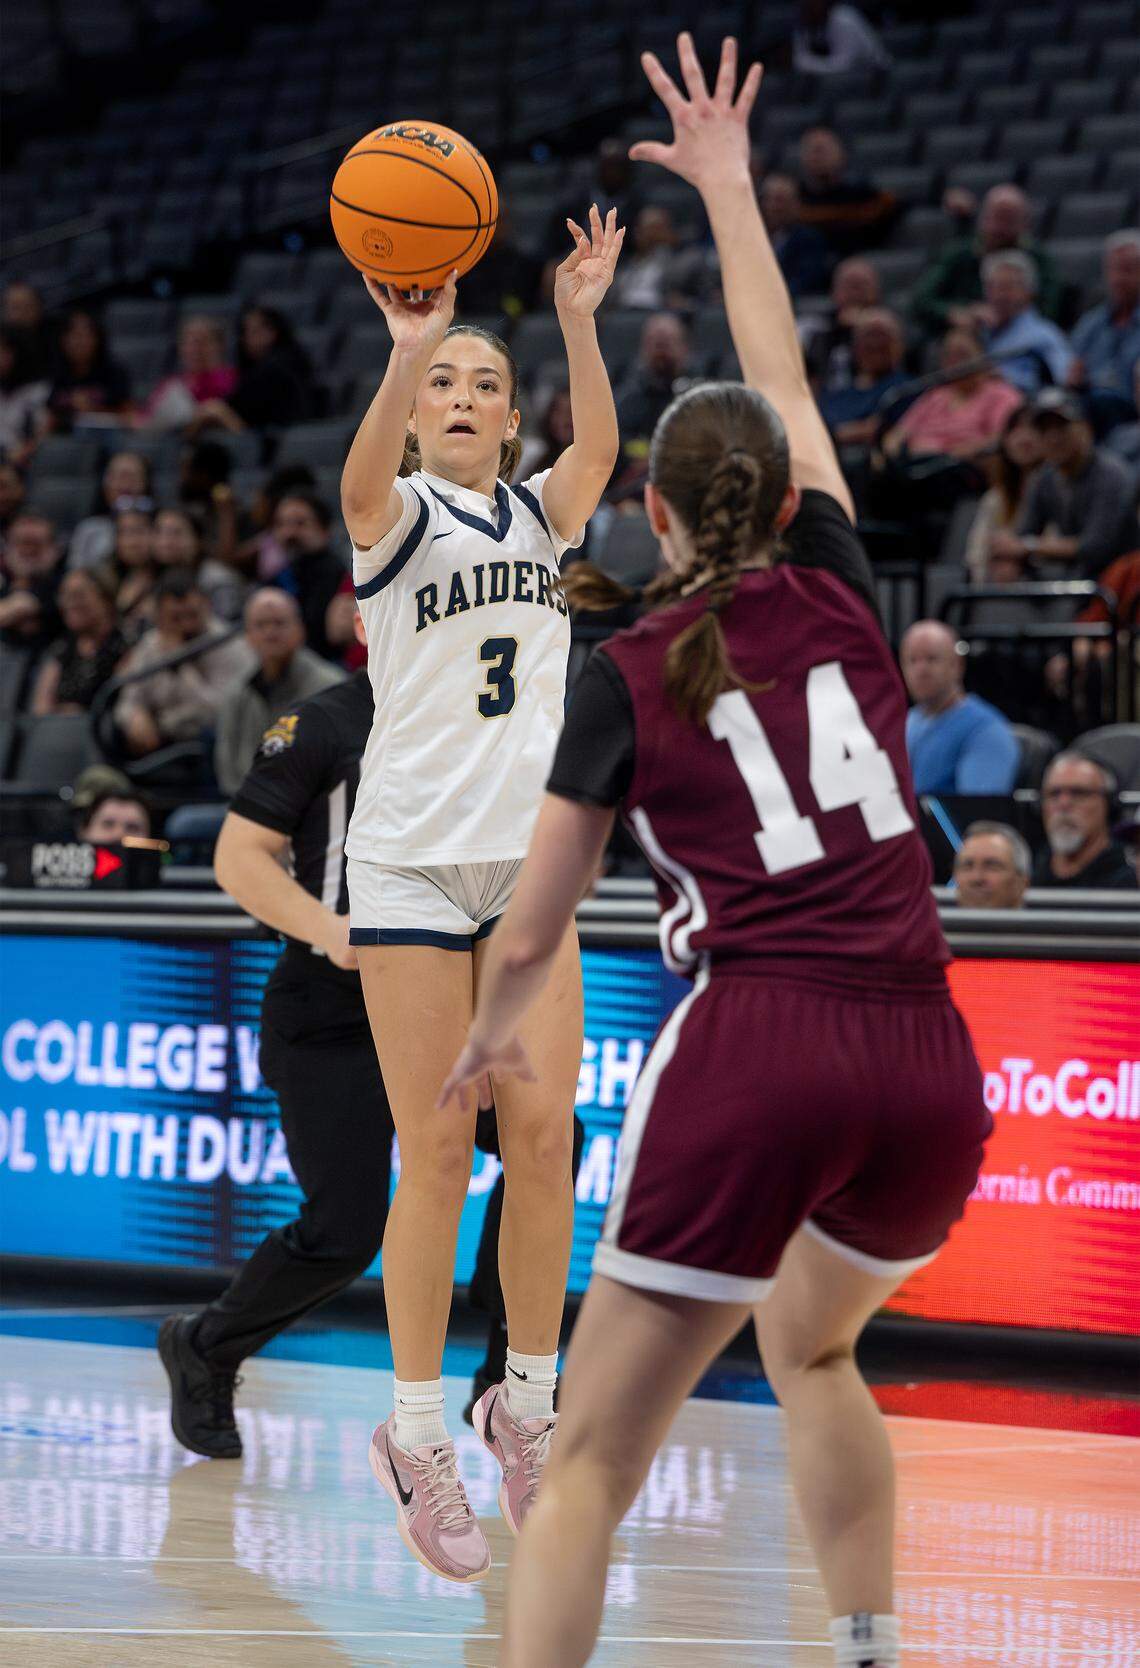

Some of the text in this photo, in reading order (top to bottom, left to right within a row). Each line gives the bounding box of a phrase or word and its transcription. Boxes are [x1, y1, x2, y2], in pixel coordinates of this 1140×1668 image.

[376, 125, 456, 158] NCAA
[476, 633, 519, 720] 3
[706, 660, 916, 877] 14
[2, 1018, 229, 1093] COLLEGE
[44, 1108, 179, 1181] WITH
